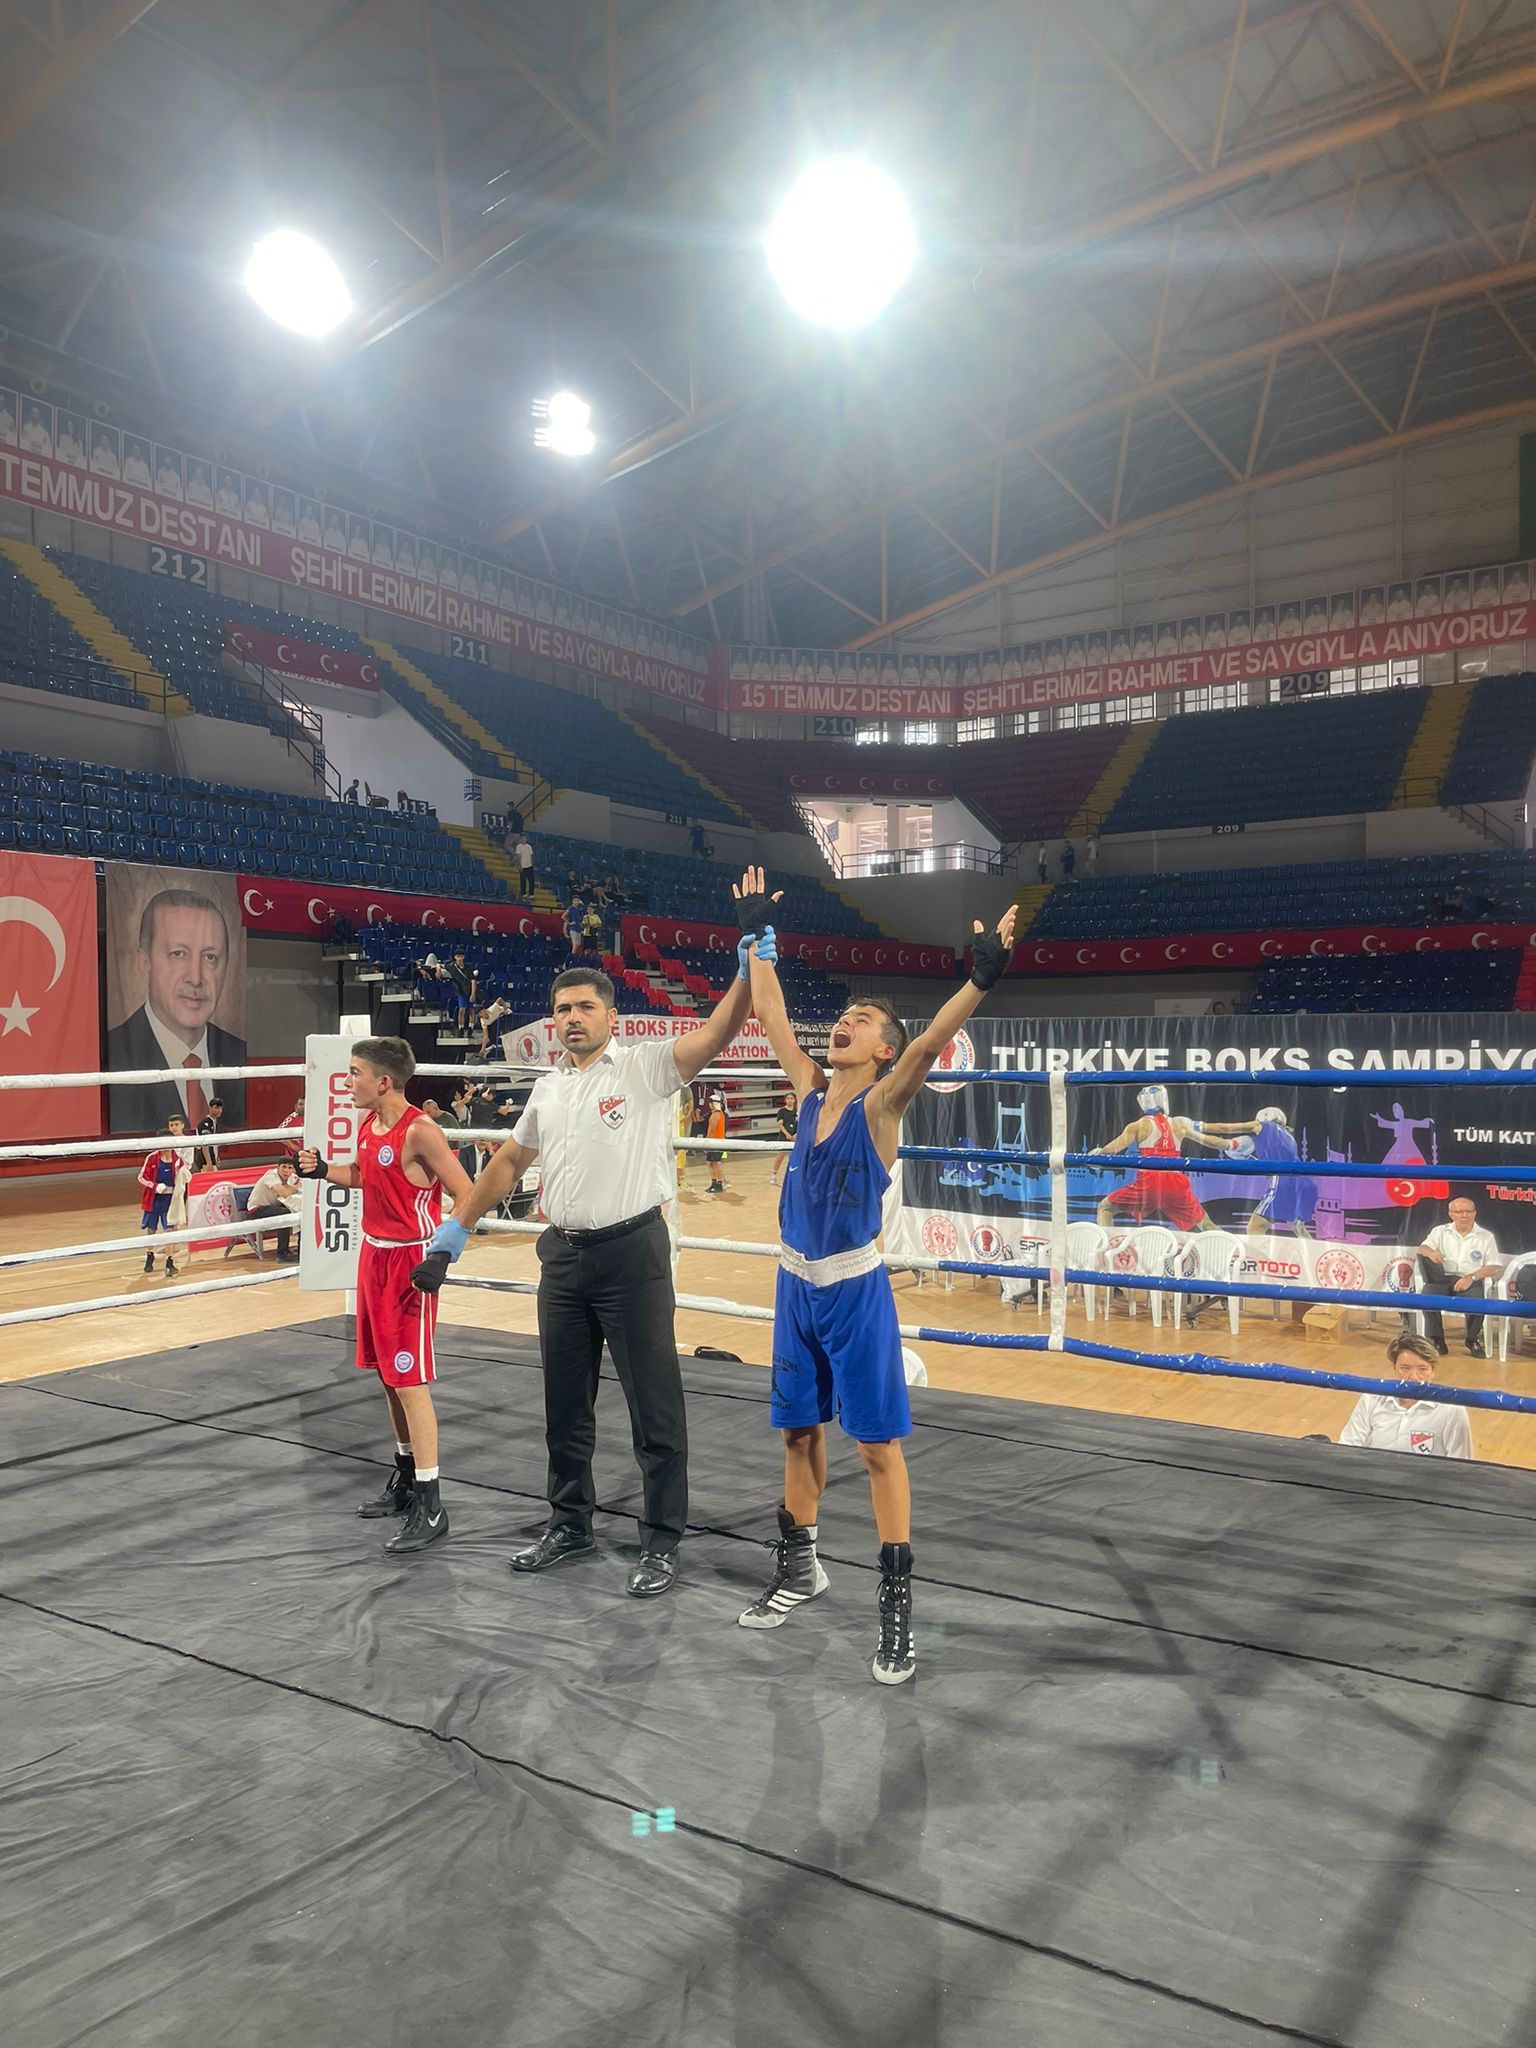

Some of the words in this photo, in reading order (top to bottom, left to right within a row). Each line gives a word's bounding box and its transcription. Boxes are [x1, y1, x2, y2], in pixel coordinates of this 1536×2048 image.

[151, 546, 207, 586] 212
[0, 451, 135, 528] TEMMUZ
[140, 495, 261, 567] DESTANI
[290, 546, 442, 622] ŞEHİTLERİMİZİ
[446, 597, 523, 647] RAHMET
[527, 624, 550, 655] VE
[553, 628, 632, 681] SAYGIYLA
[633, 661, 706, 702] ANIYORUZ
[452, 635, 489, 666] 211
[741, 684, 765, 708] 15
[771, 687, 858, 712] TEMMUZ
[861, 688, 951, 713] DESTANI
[963, 666, 1103, 716] ŞEHİTLERİMİZİ
[1108, 656, 1203, 692] RAHMET
[1208, 650, 1241, 678] VE
[1383, 607, 1527, 653] ANIYORUZ
[1281, 671, 1329, 695] 209
[815, 718, 854, 736] 210
[402, 799, 427, 816] 113
[483, 813, 504, 828] 111
[669, 814, 682, 824] 211
[1216, 825, 1239, 834] 209
[625, 1020, 667, 1037] BOKS
[991, 1041, 1169, 1072] TÜRKİYE
[1186, 1047, 1311, 1071] BOKS
[1453, 1126, 1493, 1143] TÜM
[1498, 1130, 1535, 1145] KAT
